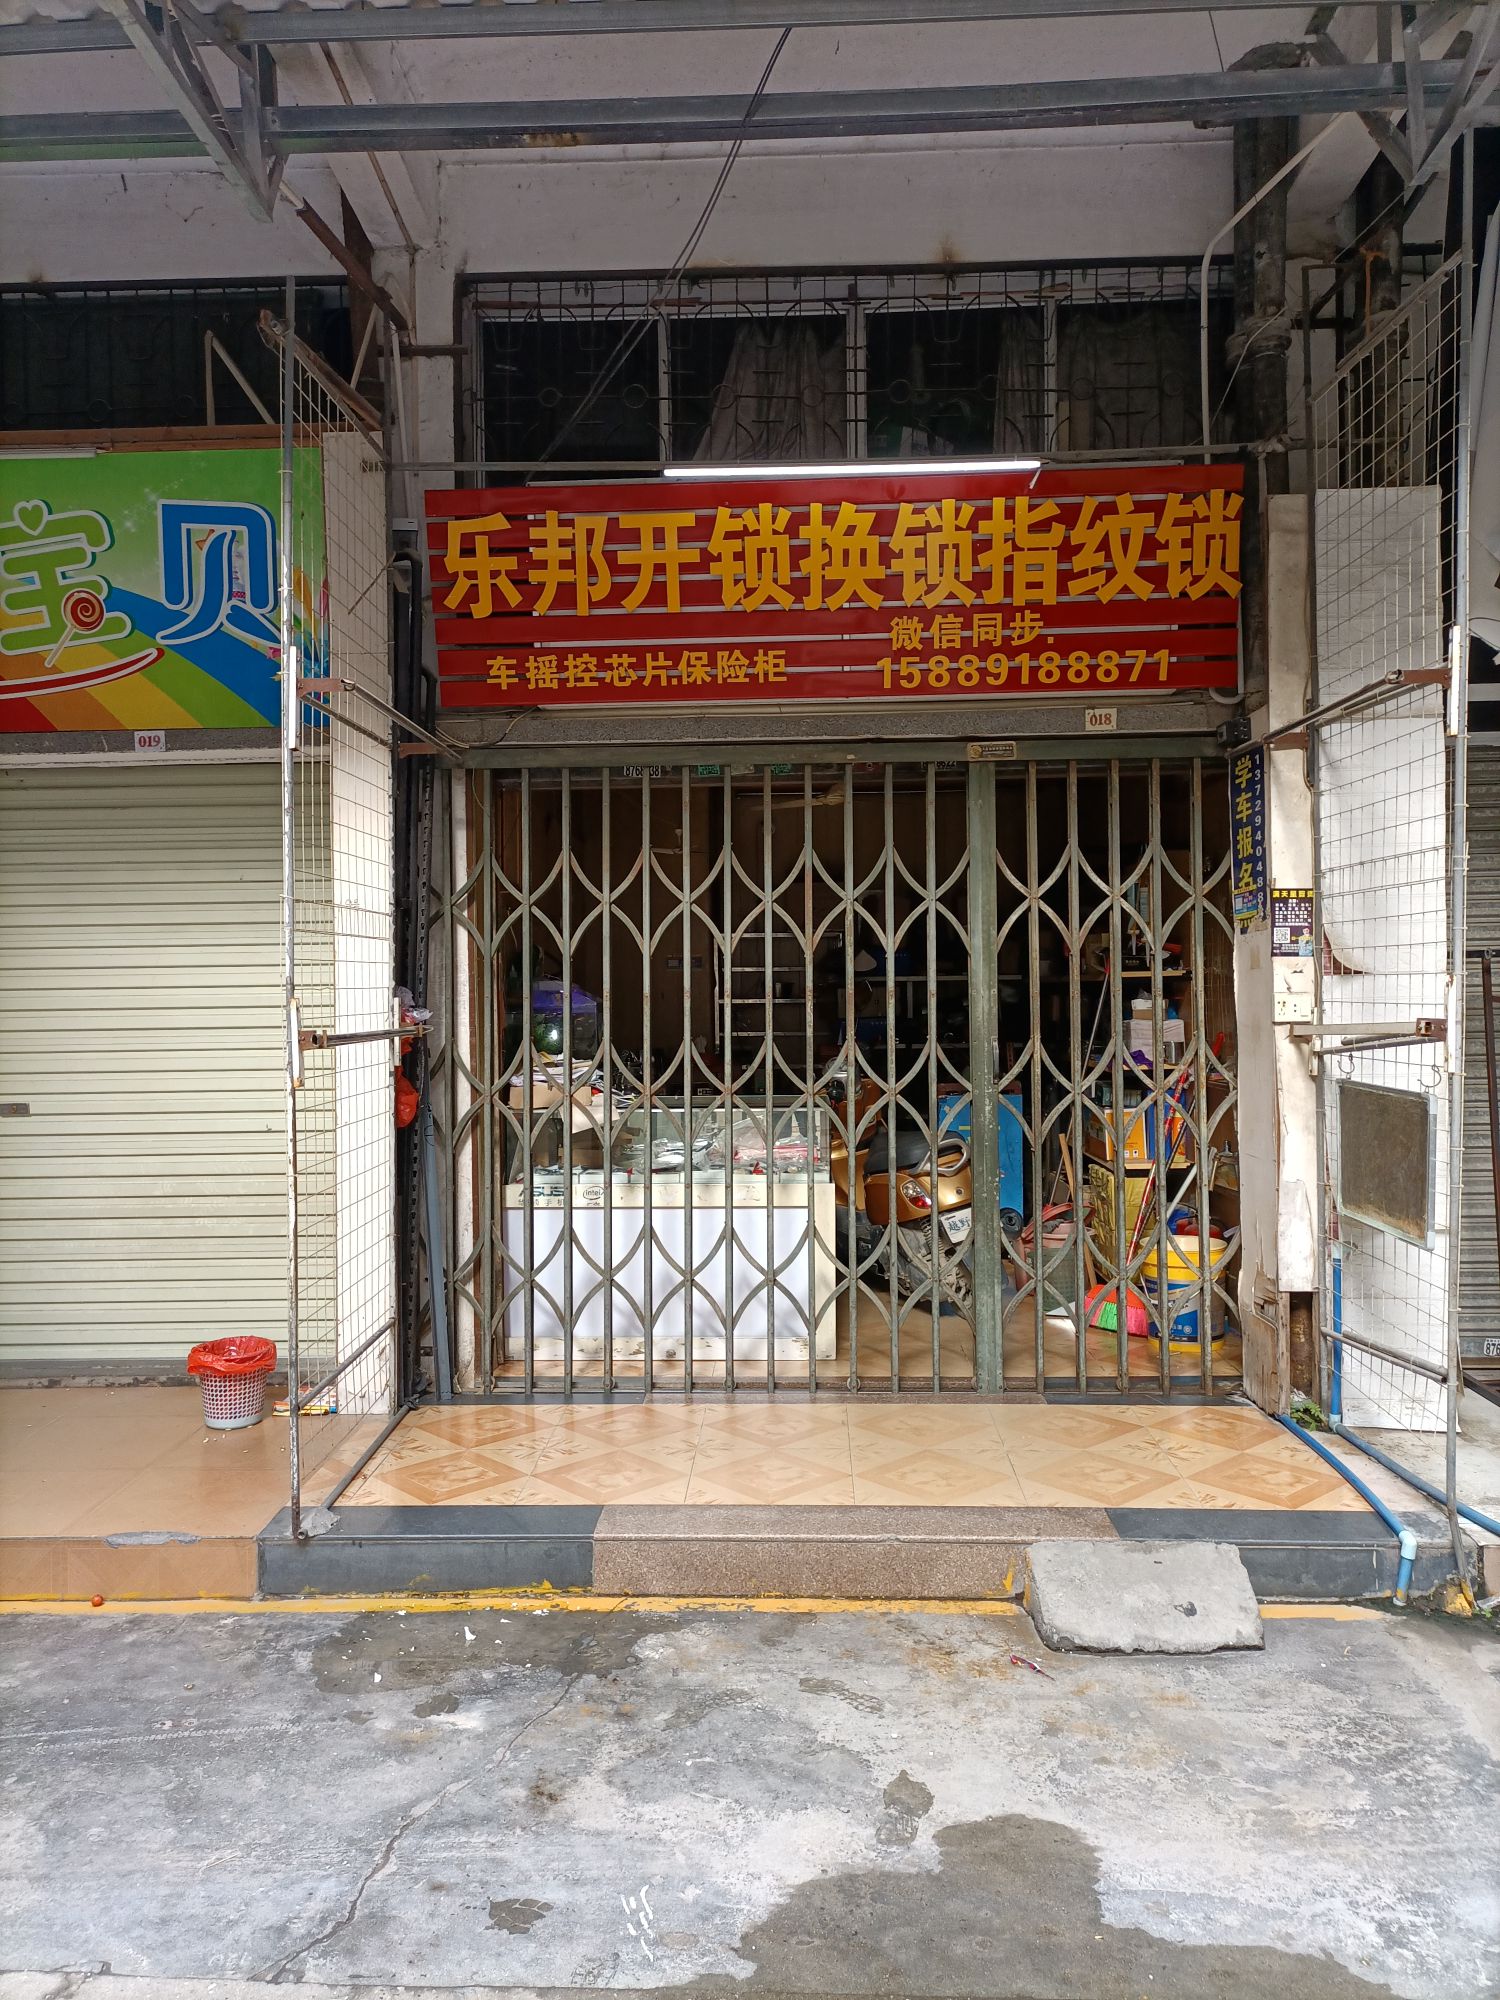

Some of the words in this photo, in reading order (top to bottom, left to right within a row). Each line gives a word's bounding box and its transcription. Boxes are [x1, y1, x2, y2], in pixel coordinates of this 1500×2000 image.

[0, 499, 281, 656] 宝贝
[442, 489, 1244, 619] 乐邦开锁换锁指纹锁
[876, 649, 1169, 689] 15889188871
[138, 735, 161, 748] 019
[1089, 712, 1112, 727] 018
[1235, 755, 1254, 890] 学车报名
